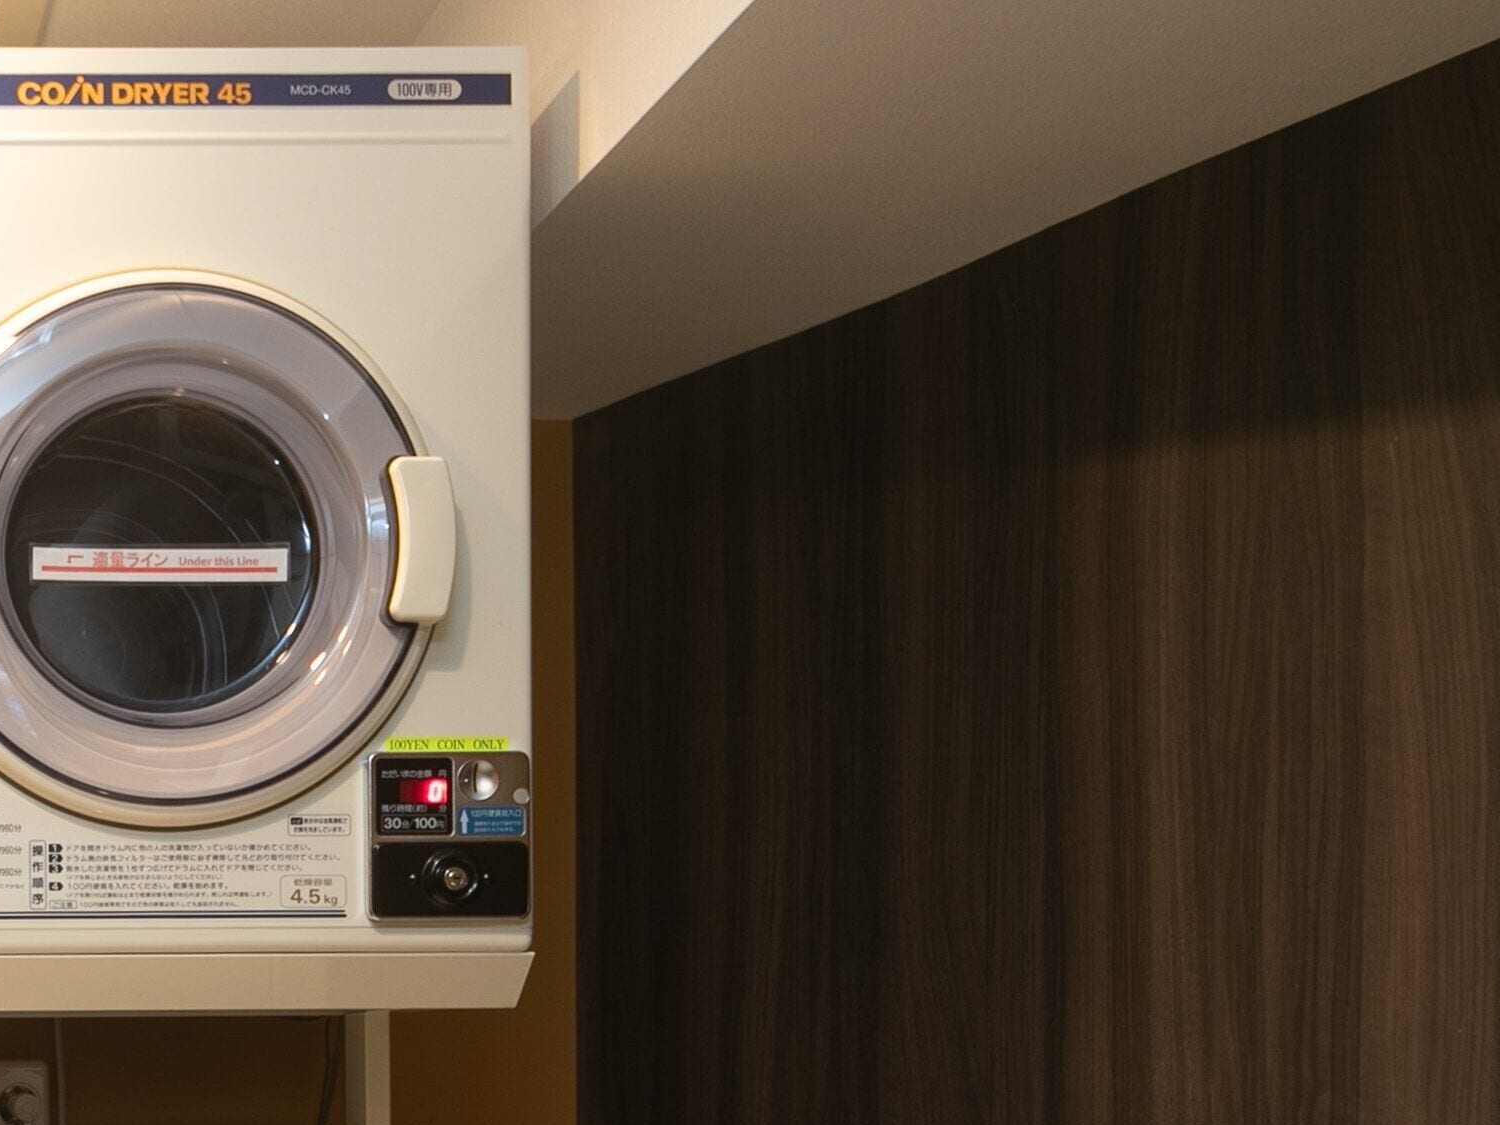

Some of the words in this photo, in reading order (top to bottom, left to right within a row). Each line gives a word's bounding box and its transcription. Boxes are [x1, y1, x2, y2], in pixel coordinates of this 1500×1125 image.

[111, 82, 210, 104] DRYER
[217, 82, 252, 104] 45
[290, 84, 351, 96] MCD-CK45
[396, 82, 453, 97] 100V専用
[93, 552, 168, 567] 適量ライン
[178, 556, 212, 566] Under
[215, 556, 235, 566] this
[237, 556, 259, 566] Line
[389, 740, 430, 750] 100YEN
[437, 739, 465, 750] COIN
[473, 739, 505, 750] ONLY
[428, 781, 443, 803] 0
[290, 889, 320, 904] 4.5
[323, 895, 338, 907] kg
